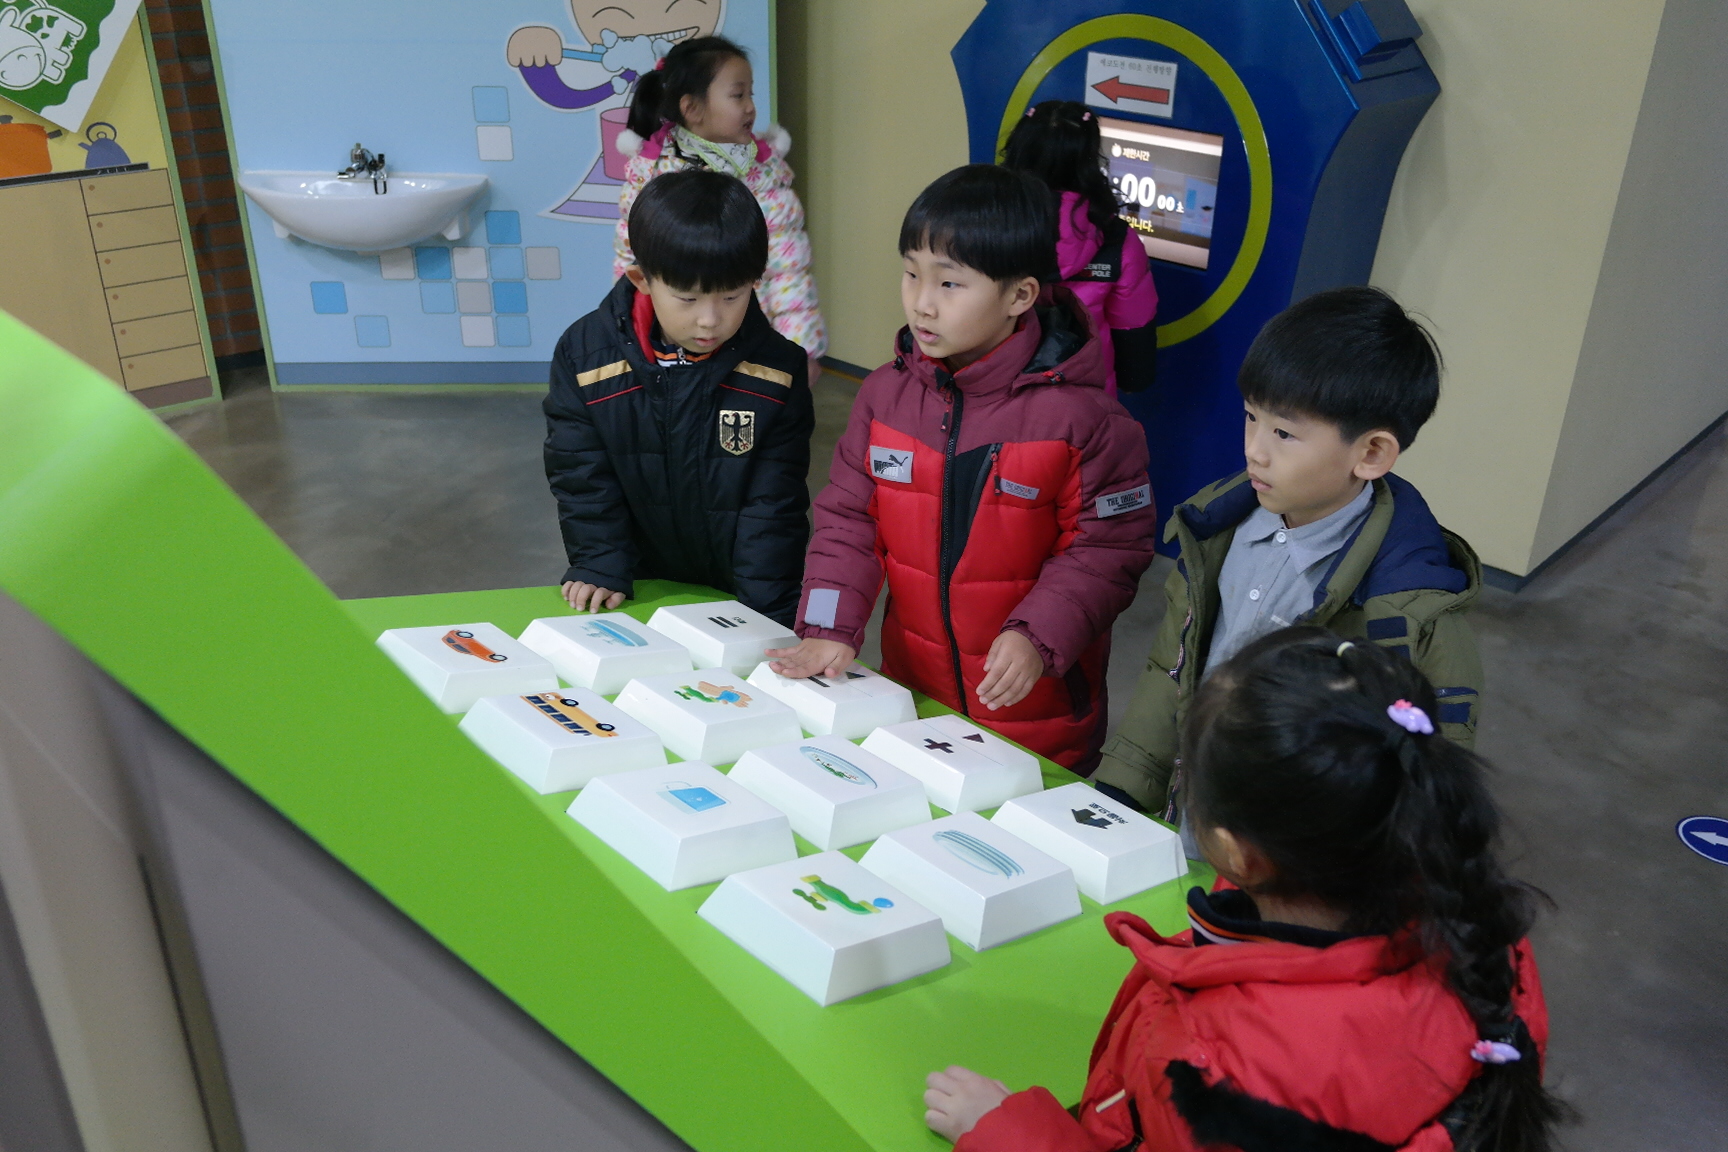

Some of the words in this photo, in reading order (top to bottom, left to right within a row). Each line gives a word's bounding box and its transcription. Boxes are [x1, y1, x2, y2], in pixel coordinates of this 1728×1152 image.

[1122, 147, 1151, 162] 제한시간
[1118, 214, 1154, 233] 입니다.
[1084, 263, 1112, 271] ENTER
[1092, 270, 1112, 278] POLE
[1106, 496, 1120, 507] THE
